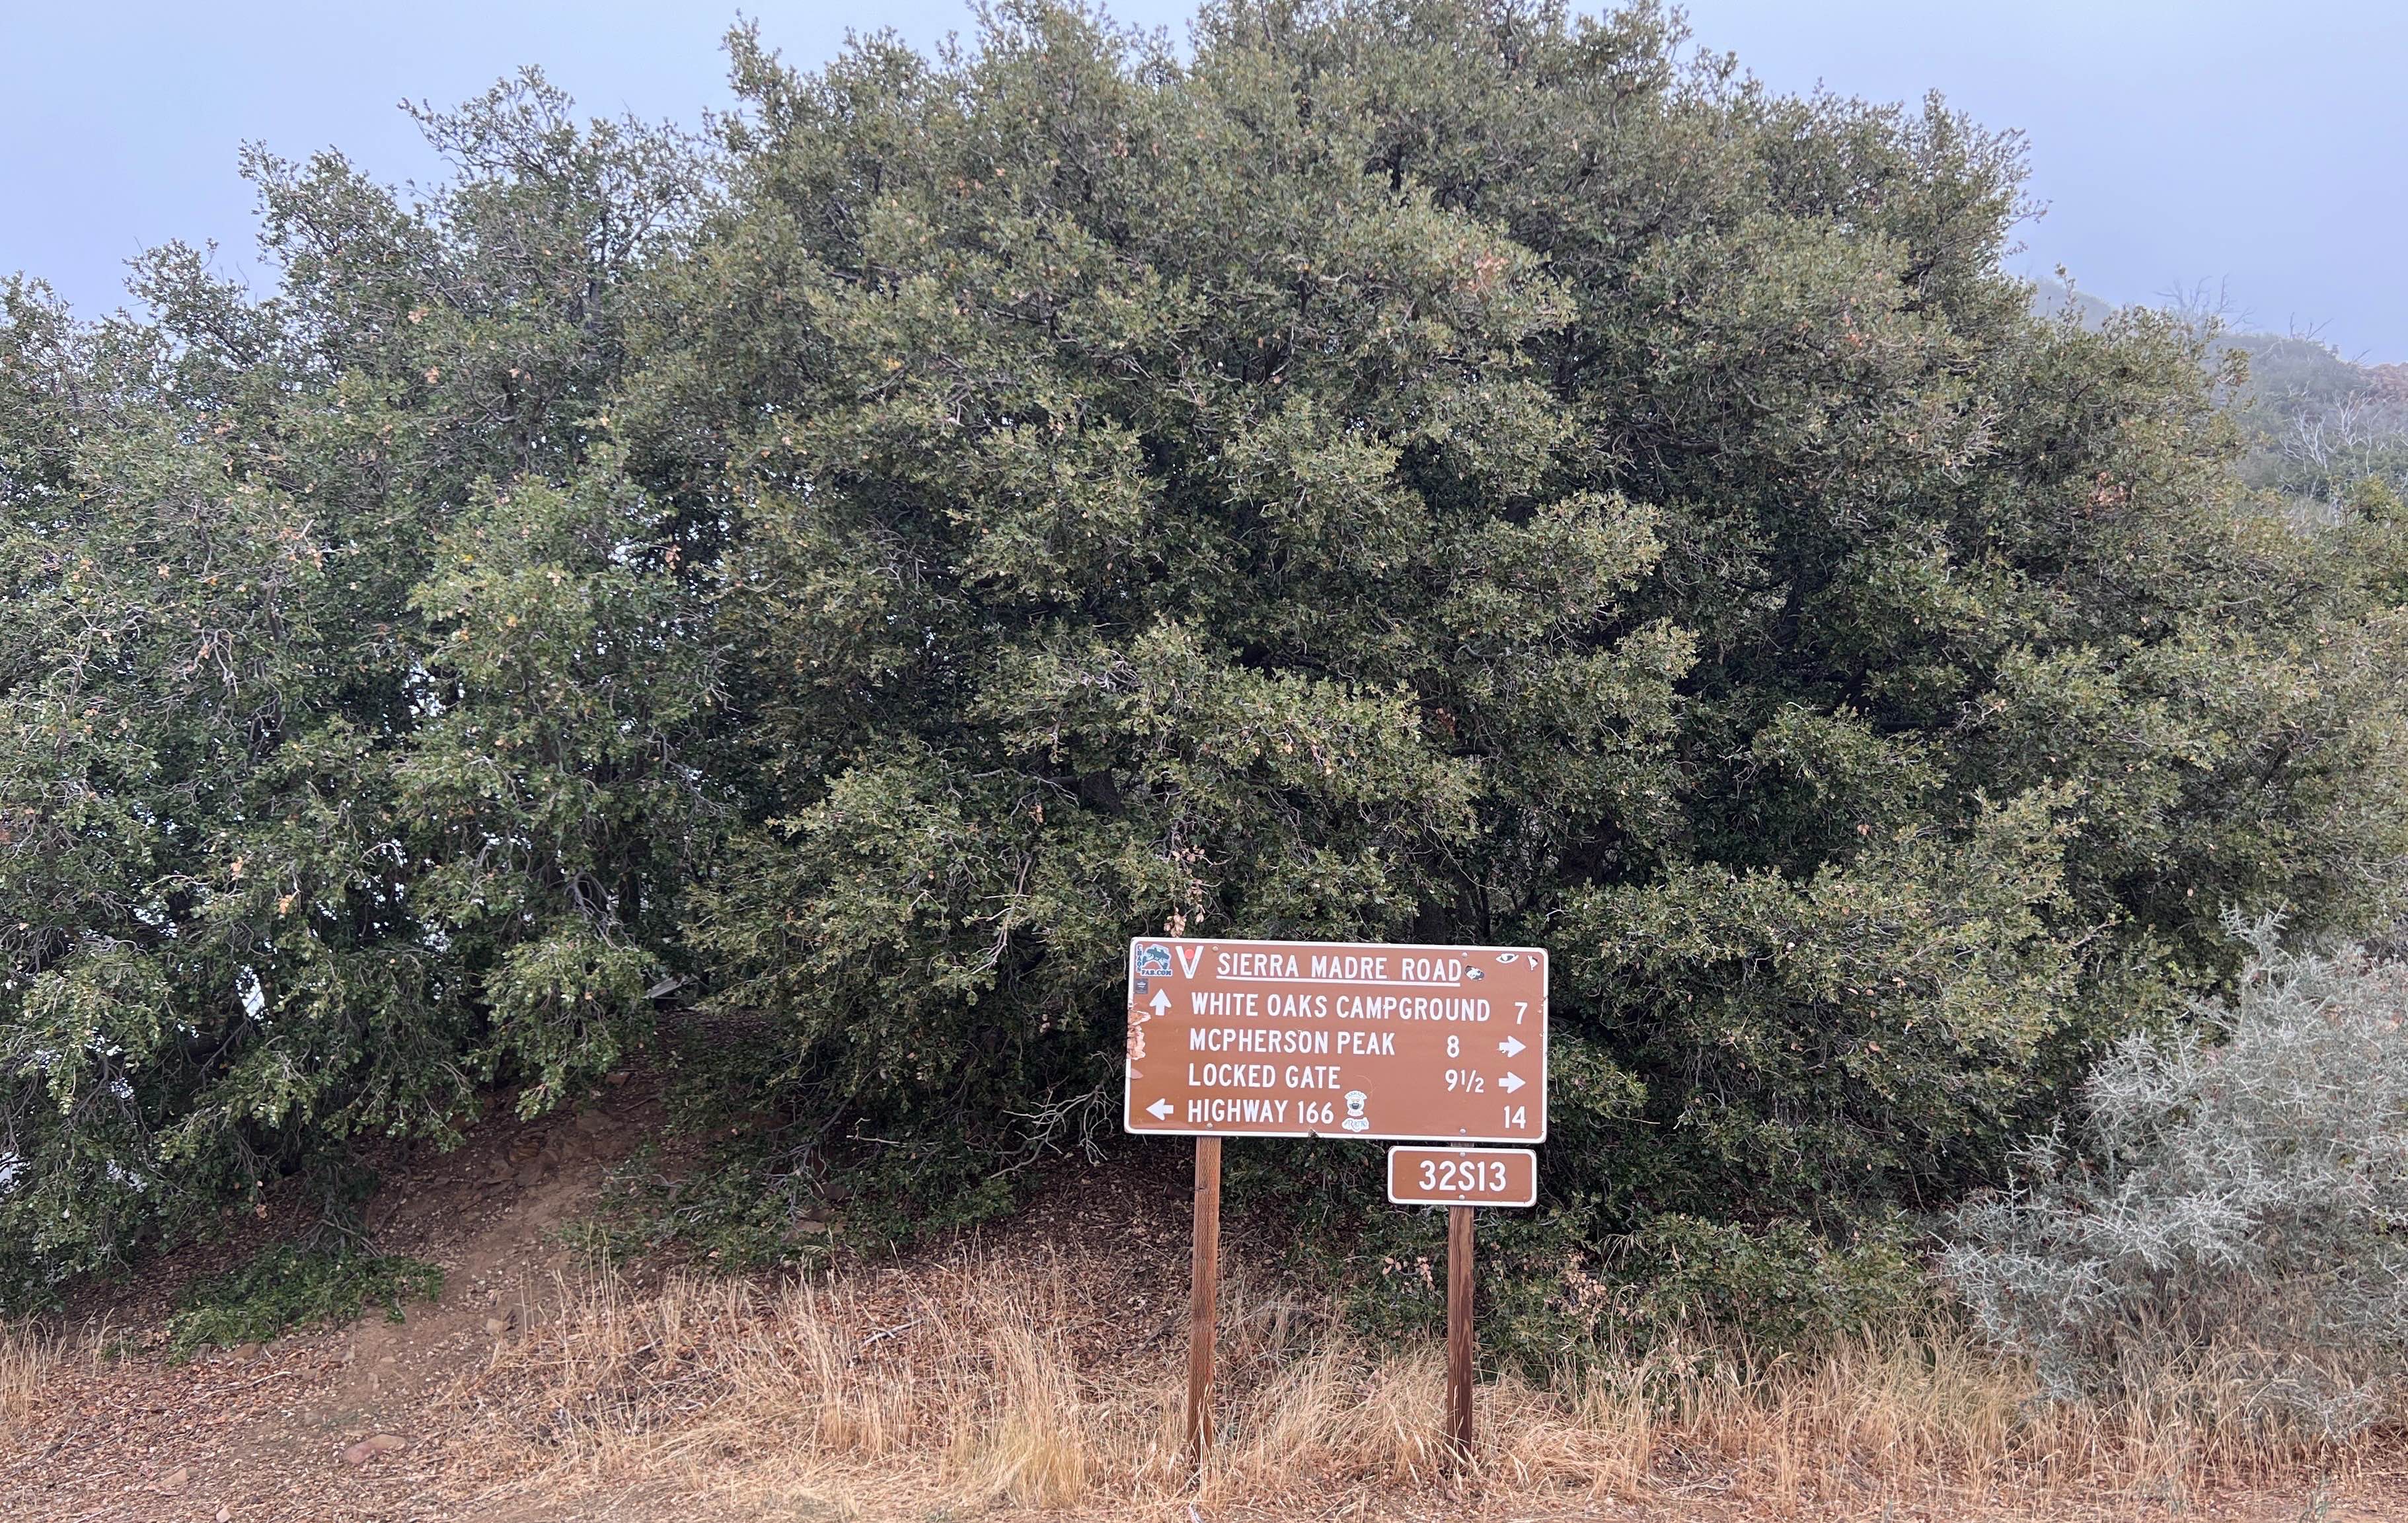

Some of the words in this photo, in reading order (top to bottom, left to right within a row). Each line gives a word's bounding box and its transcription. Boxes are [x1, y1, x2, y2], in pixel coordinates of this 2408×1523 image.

[1217, 952, 1299, 978] SIERRA
[1311, 955, 1388, 980] MADRE
[1402, 957, 1462, 982] ROAD
[1191, 992, 1259, 1017] WHITE
[1267, 993, 1328, 1018] OAKS
[1336, 995, 1490, 1022] CAMPGROUND
[1514, 1002, 1528, 1025] 7
[1189, 1027, 1328, 1054] MCPHERSON
[1337, 1031, 1396, 1056] PEAK
[1447, 1035, 1460, 1059] 8
[1188, 1062, 1276, 1088] LOCKED
[1285, 1065, 1341, 1090] GATE
[1187, 1098, 1289, 1123] HIGHWAY
[1297, 1100, 1334, 1125] 166
[1503, 1105, 1526, 1129] 14
[1419, 1160, 1507, 1192] 32S13
